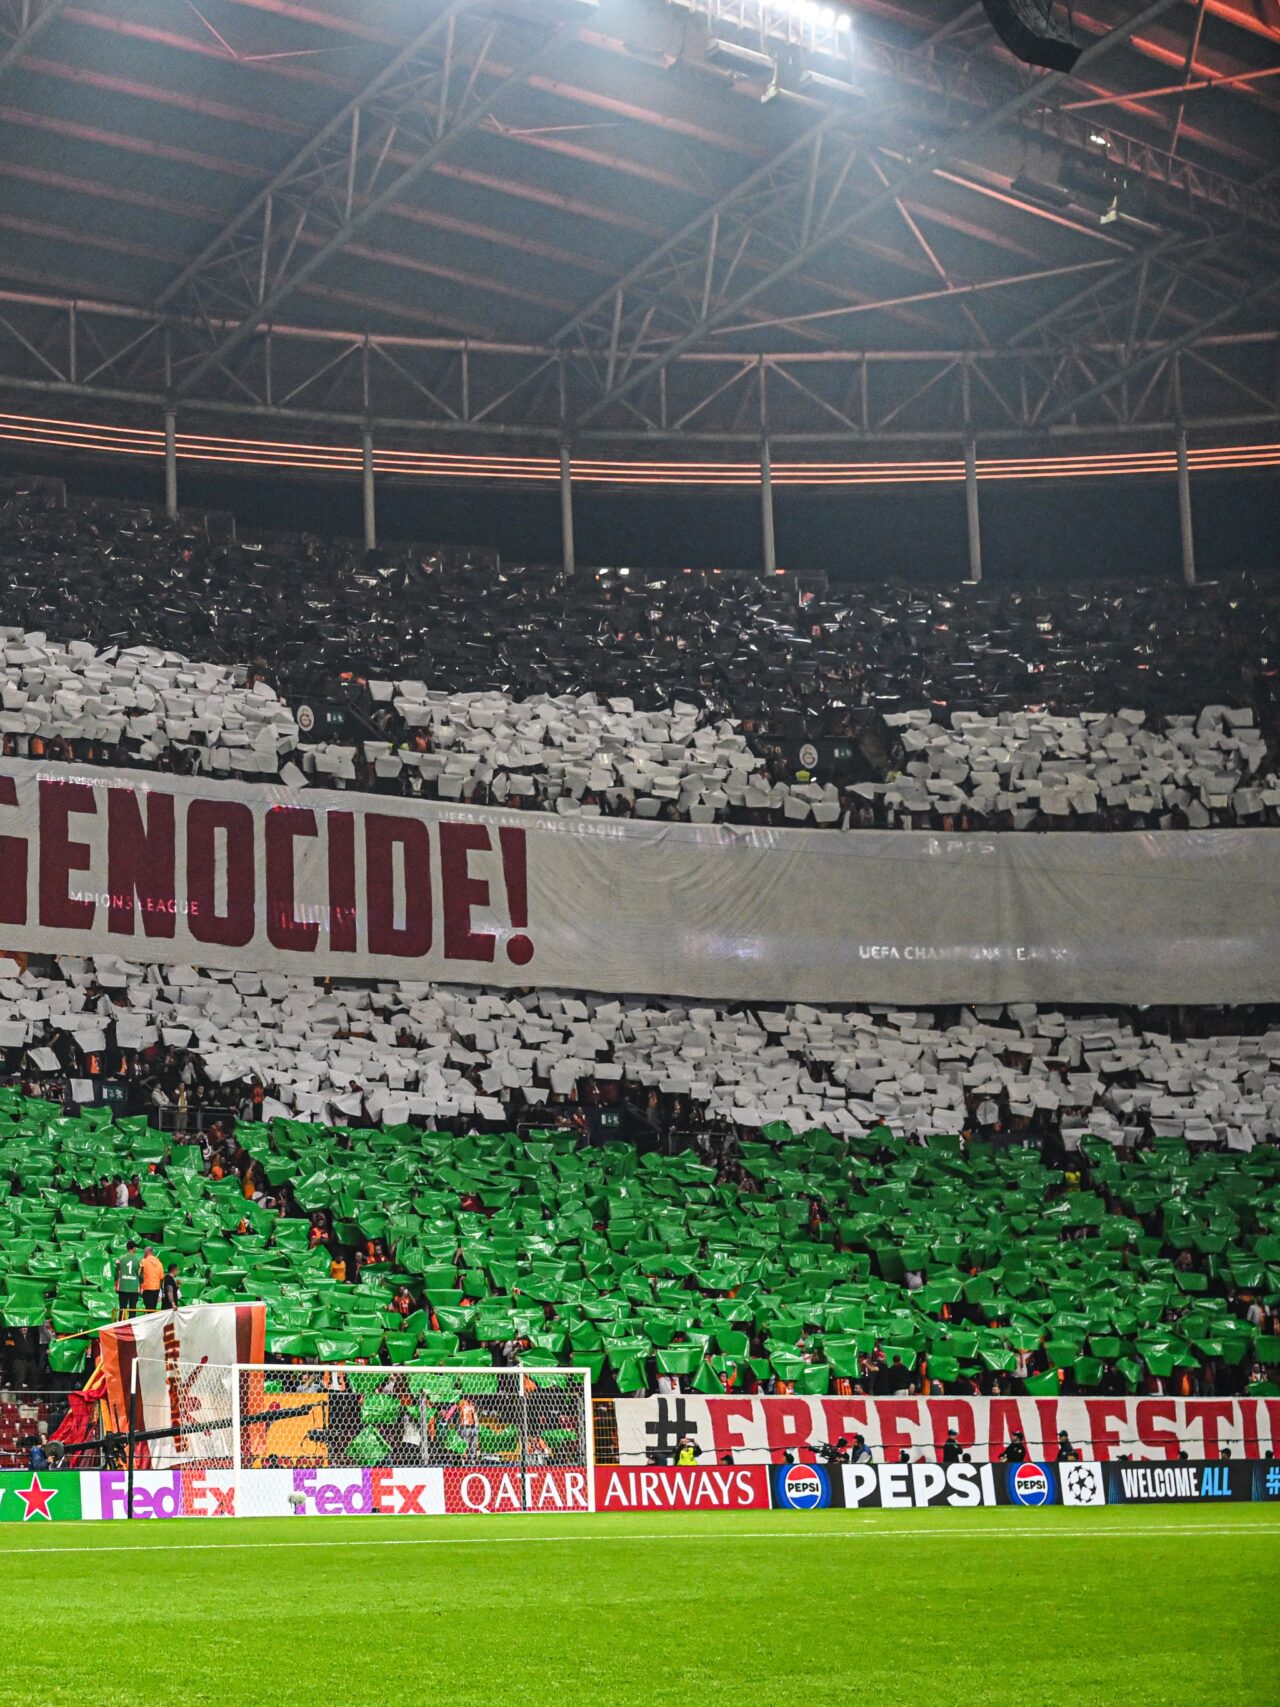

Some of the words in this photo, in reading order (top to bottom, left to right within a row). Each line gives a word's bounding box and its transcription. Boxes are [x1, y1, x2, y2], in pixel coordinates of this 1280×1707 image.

[126, 1260, 133, 1274] 1
[100, 1470, 236, 1519] FedEx
[293, 1468, 427, 1515] FedEx
[461, 1472, 589, 1513] QATAR
[604, 1471, 754, 1506] AIRWAYS
[787, 1481, 819, 1493] PEPSI
[841, 1463, 997, 1508] PEPSI
[1017, 1480, 1046, 1491] PEPSI
[1121, 1468, 1199, 1498] WELCOME
[1201, 1466, 1232, 1496] ALL
